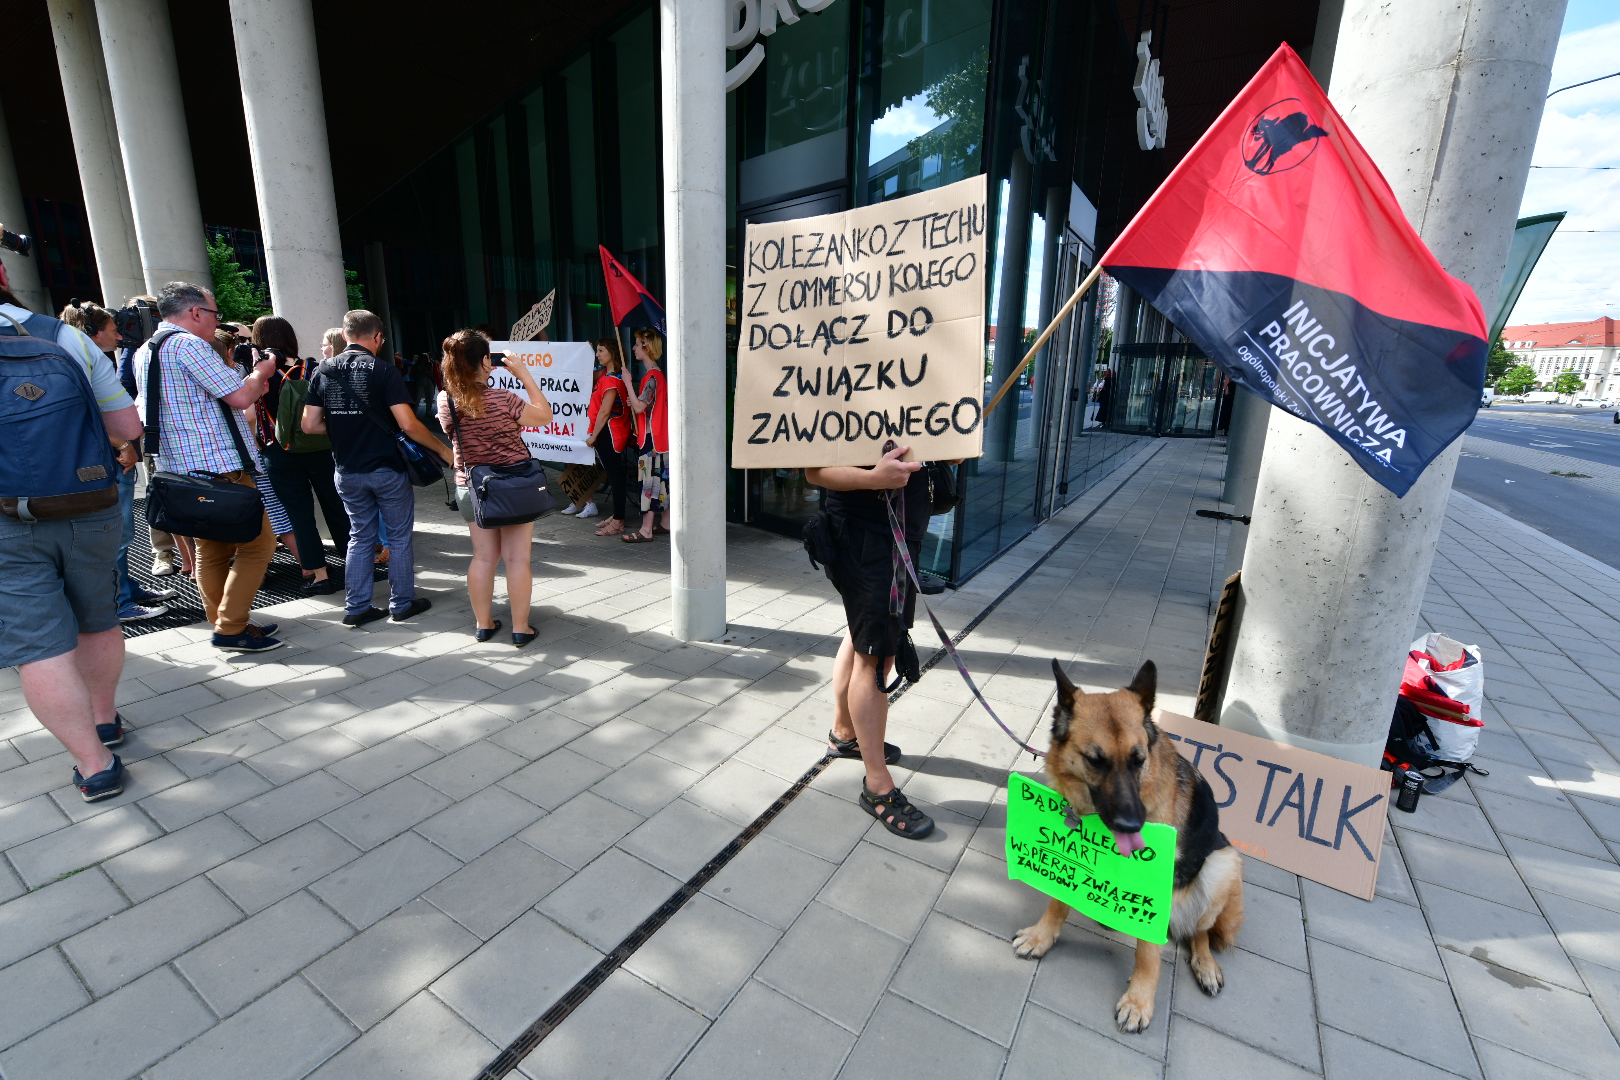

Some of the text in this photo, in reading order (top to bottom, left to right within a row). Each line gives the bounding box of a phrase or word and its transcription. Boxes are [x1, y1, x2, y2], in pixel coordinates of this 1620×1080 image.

[886, 219, 911, 257] Z
[909, 203, 986, 250] TECHU
[747, 252, 977, 318] Z COMMERSU KOLEGO
[749, 306, 934, 356] DOŁĄCZ DO
[337, 361, 376, 371] ITORS
[500, 376, 526, 390] NAS
[541, 377, 580, 393] PRACA
[520, 353, 553, 367] EGRO
[772, 353, 928, 401] ZWIĄZKU
[1237, 345, 1291, 404] Ogólnopolski
[1282, 299, 1407, 449] INICJATYWA
[549, 402, 589, 417] DOWY
[1258, 320, 1393, 464] PRACOWNICZA
[544, 422, 575, 437] SIŁA!
[747, 397, 982, 444] ZAWODOWEGO
[1194, 580, 1237, 718] RENGTH
[1164, 731, 1384, 862] T'S TALK
[1011, 836, 1076, 880] WSPIERAJ
[1036, 826, 1108, 866] SMART
[1017, 855, 1079, 892] ZAWODOWY
[1086, 891, 1110, 909] OZZ
